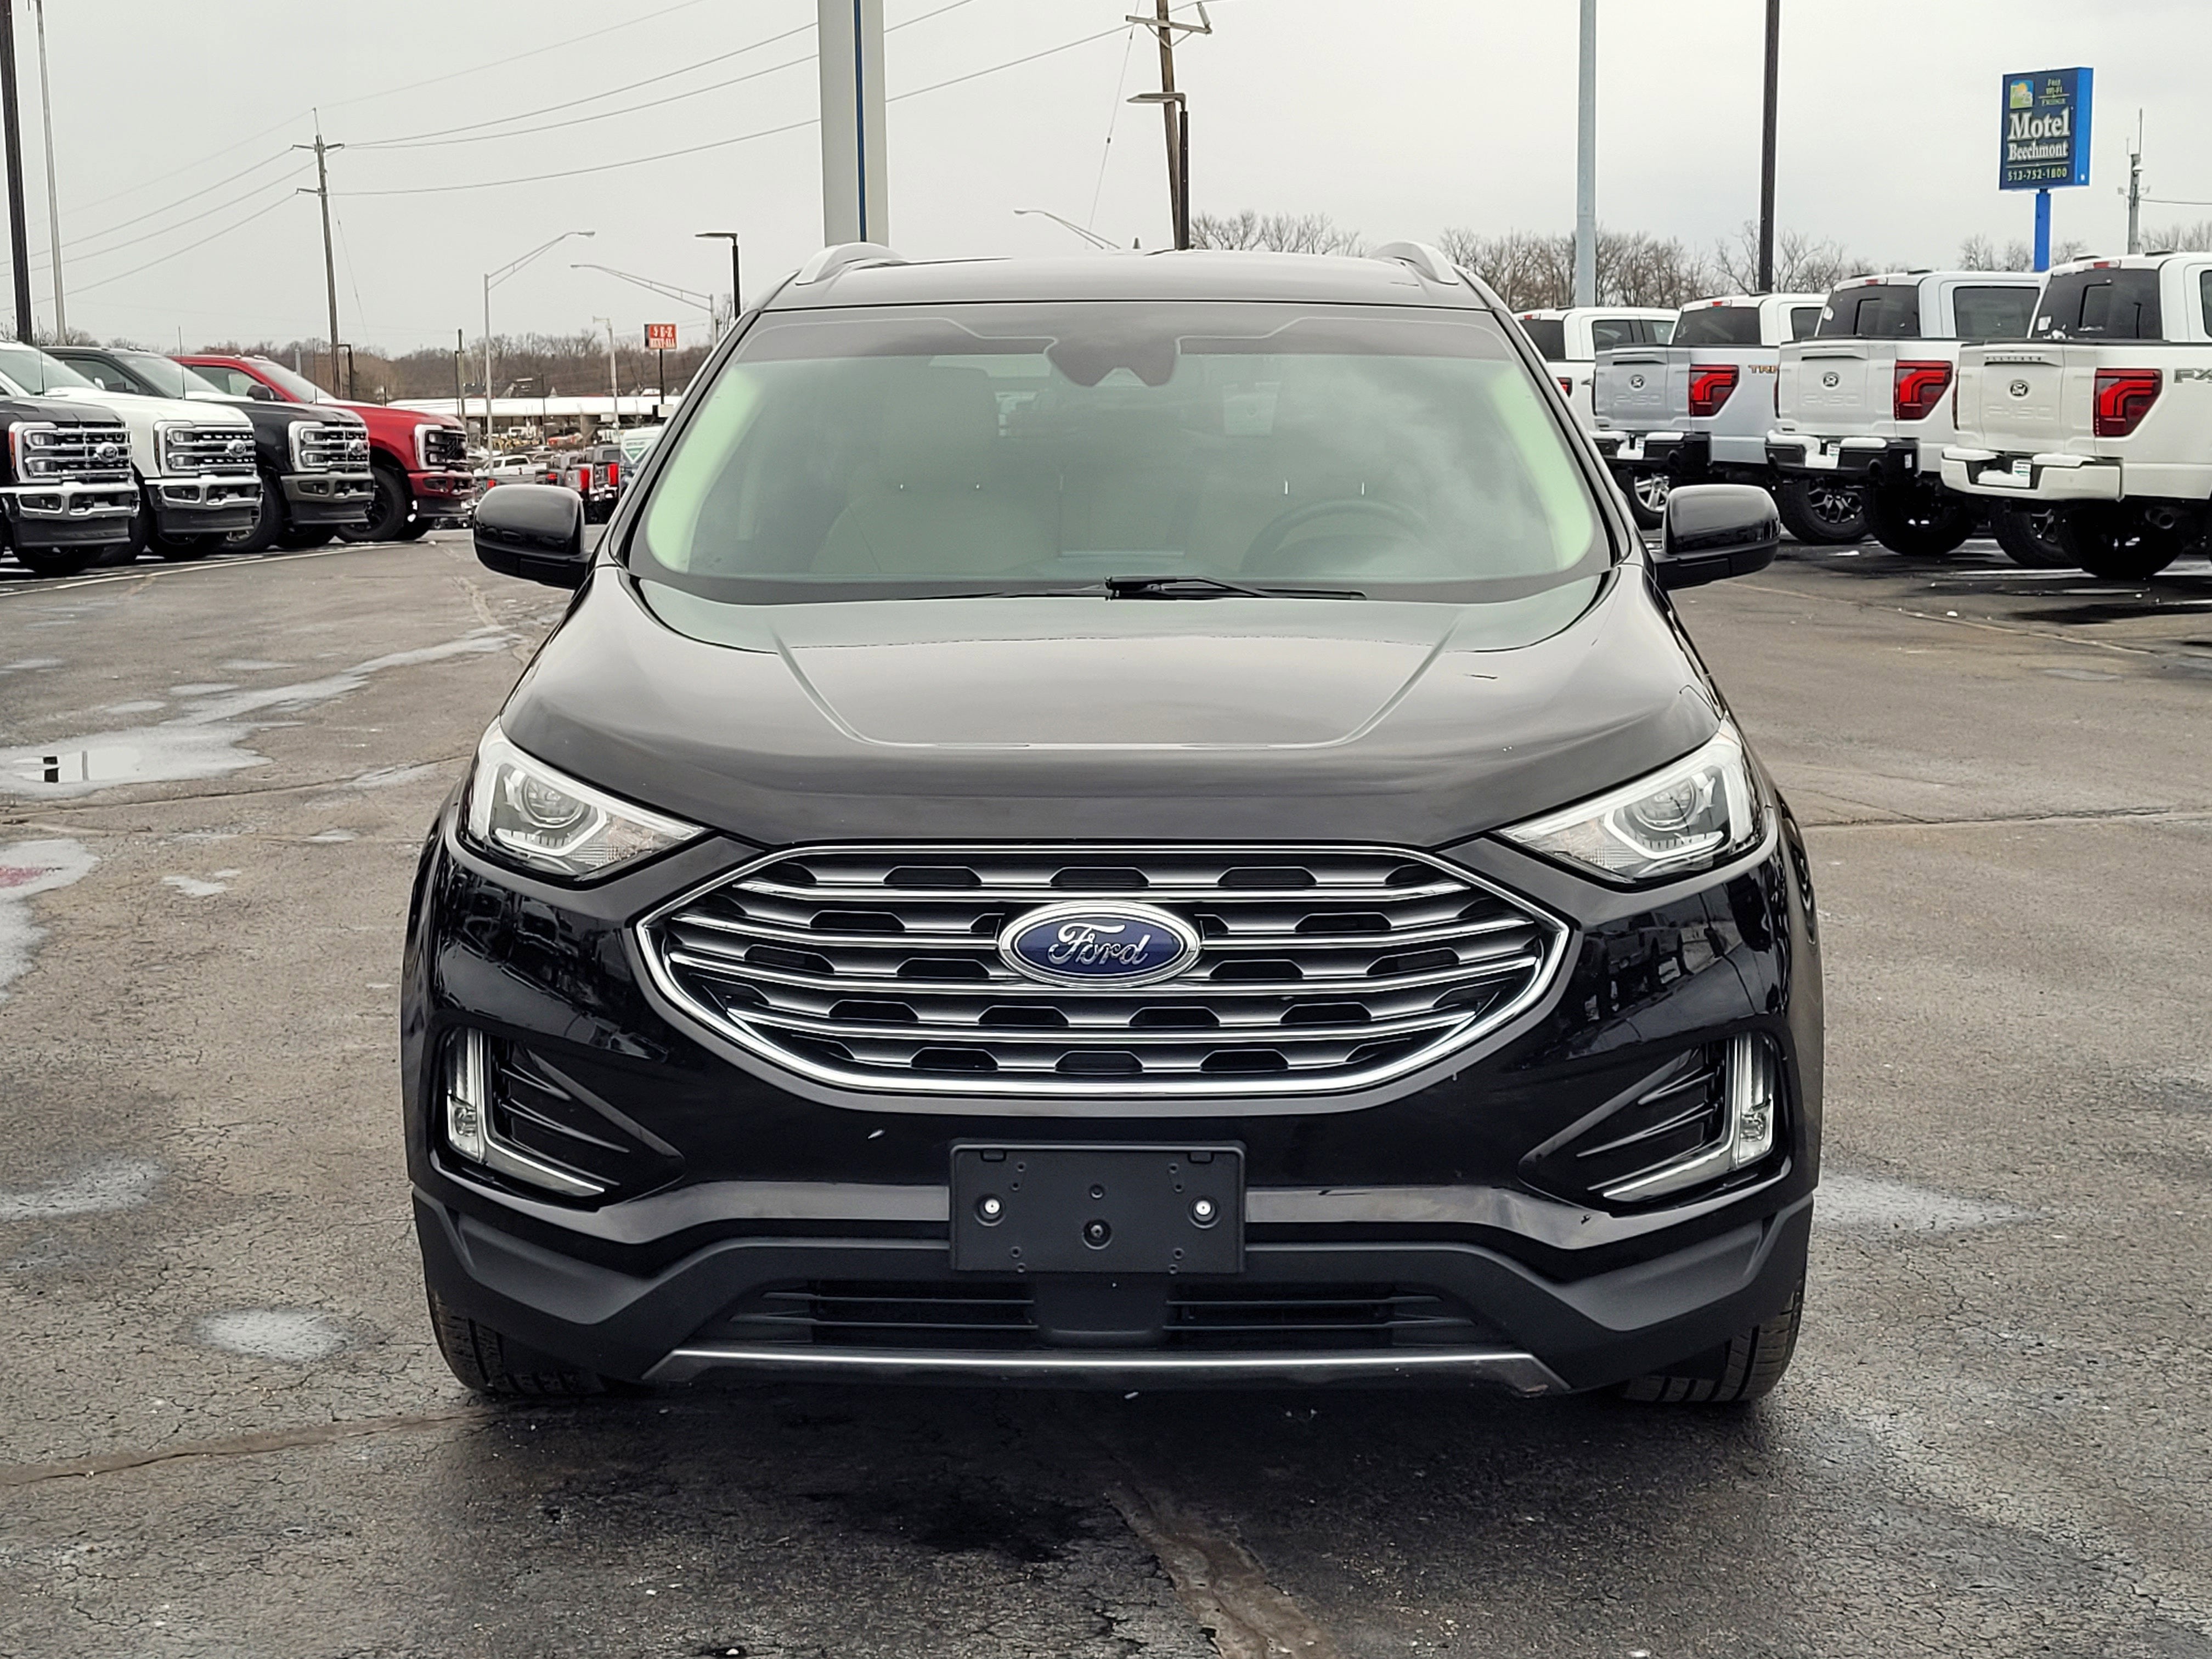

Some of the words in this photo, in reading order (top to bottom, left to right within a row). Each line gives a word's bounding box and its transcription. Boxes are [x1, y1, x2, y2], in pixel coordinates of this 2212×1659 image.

[2007, 107, 2070, 142] Motel
[2007, 139, 2068, 162] Beechmont
[2007, 167, 2067, 182] 513-752-1800
[1048, 922, 1151, 966] Ford
